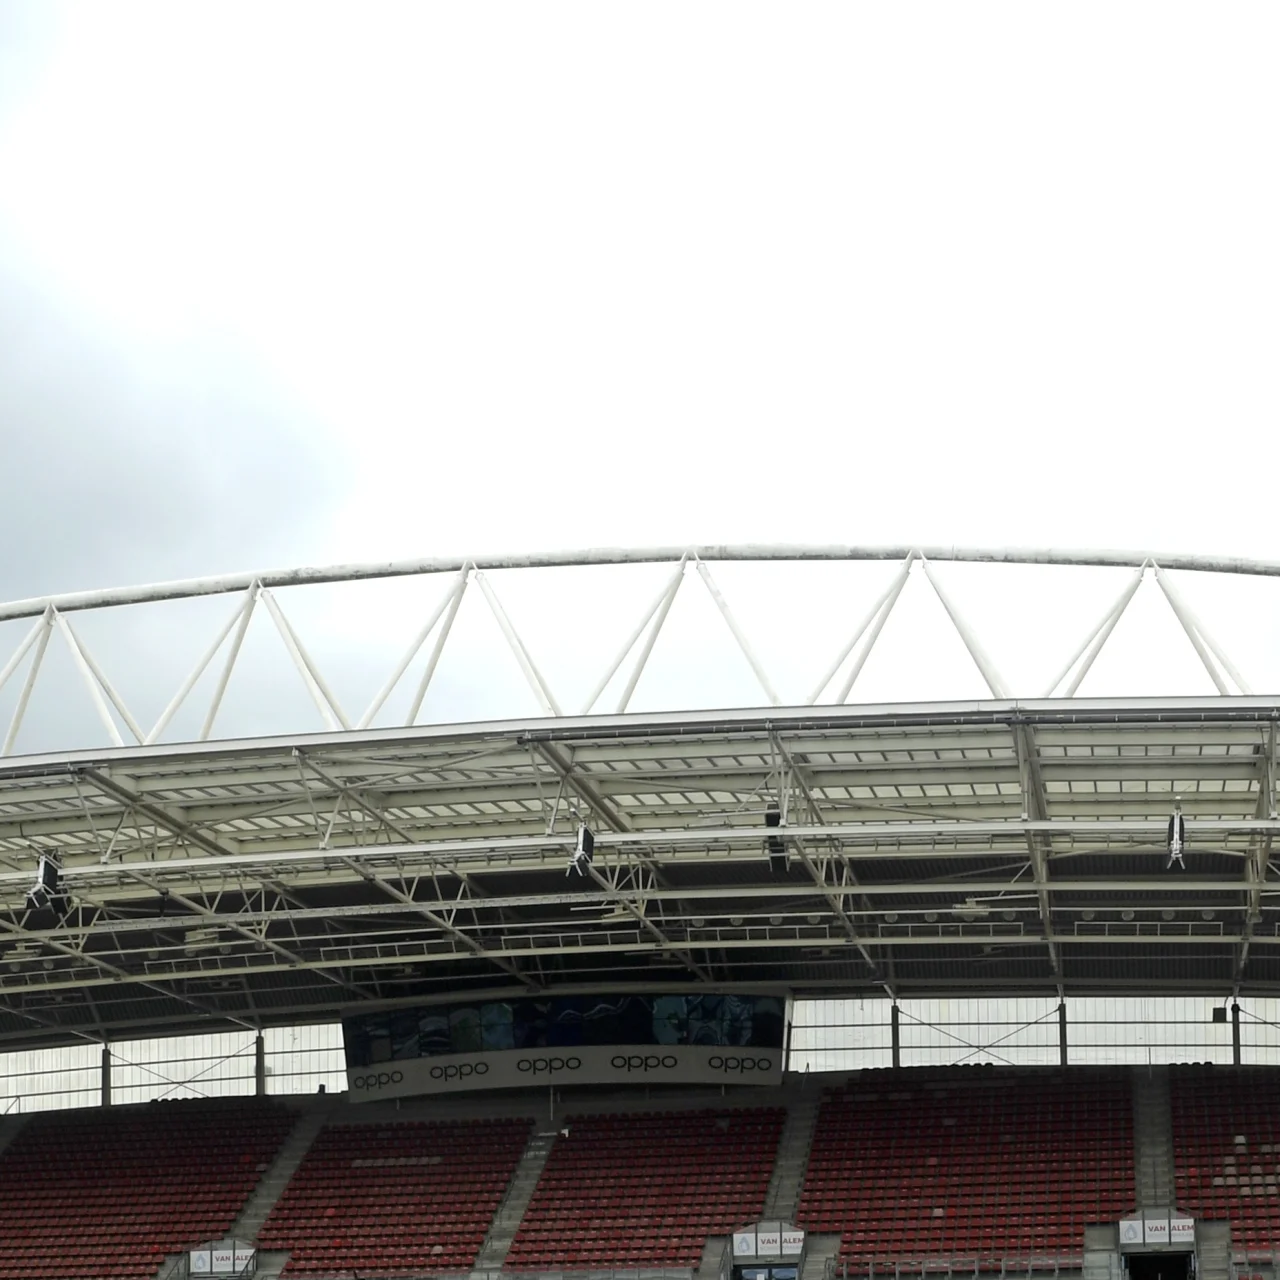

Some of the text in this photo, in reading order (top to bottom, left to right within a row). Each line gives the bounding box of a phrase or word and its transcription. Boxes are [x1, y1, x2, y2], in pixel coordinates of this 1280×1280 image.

[429, 1062, 489, 1082] oppo
[516, 1056, 581, 1076] oppo
[611, 1055, 677, 1075] oppo
[708, 1056, 772, 1074] oppo
[354, 1071, 403, 1090] oppo
